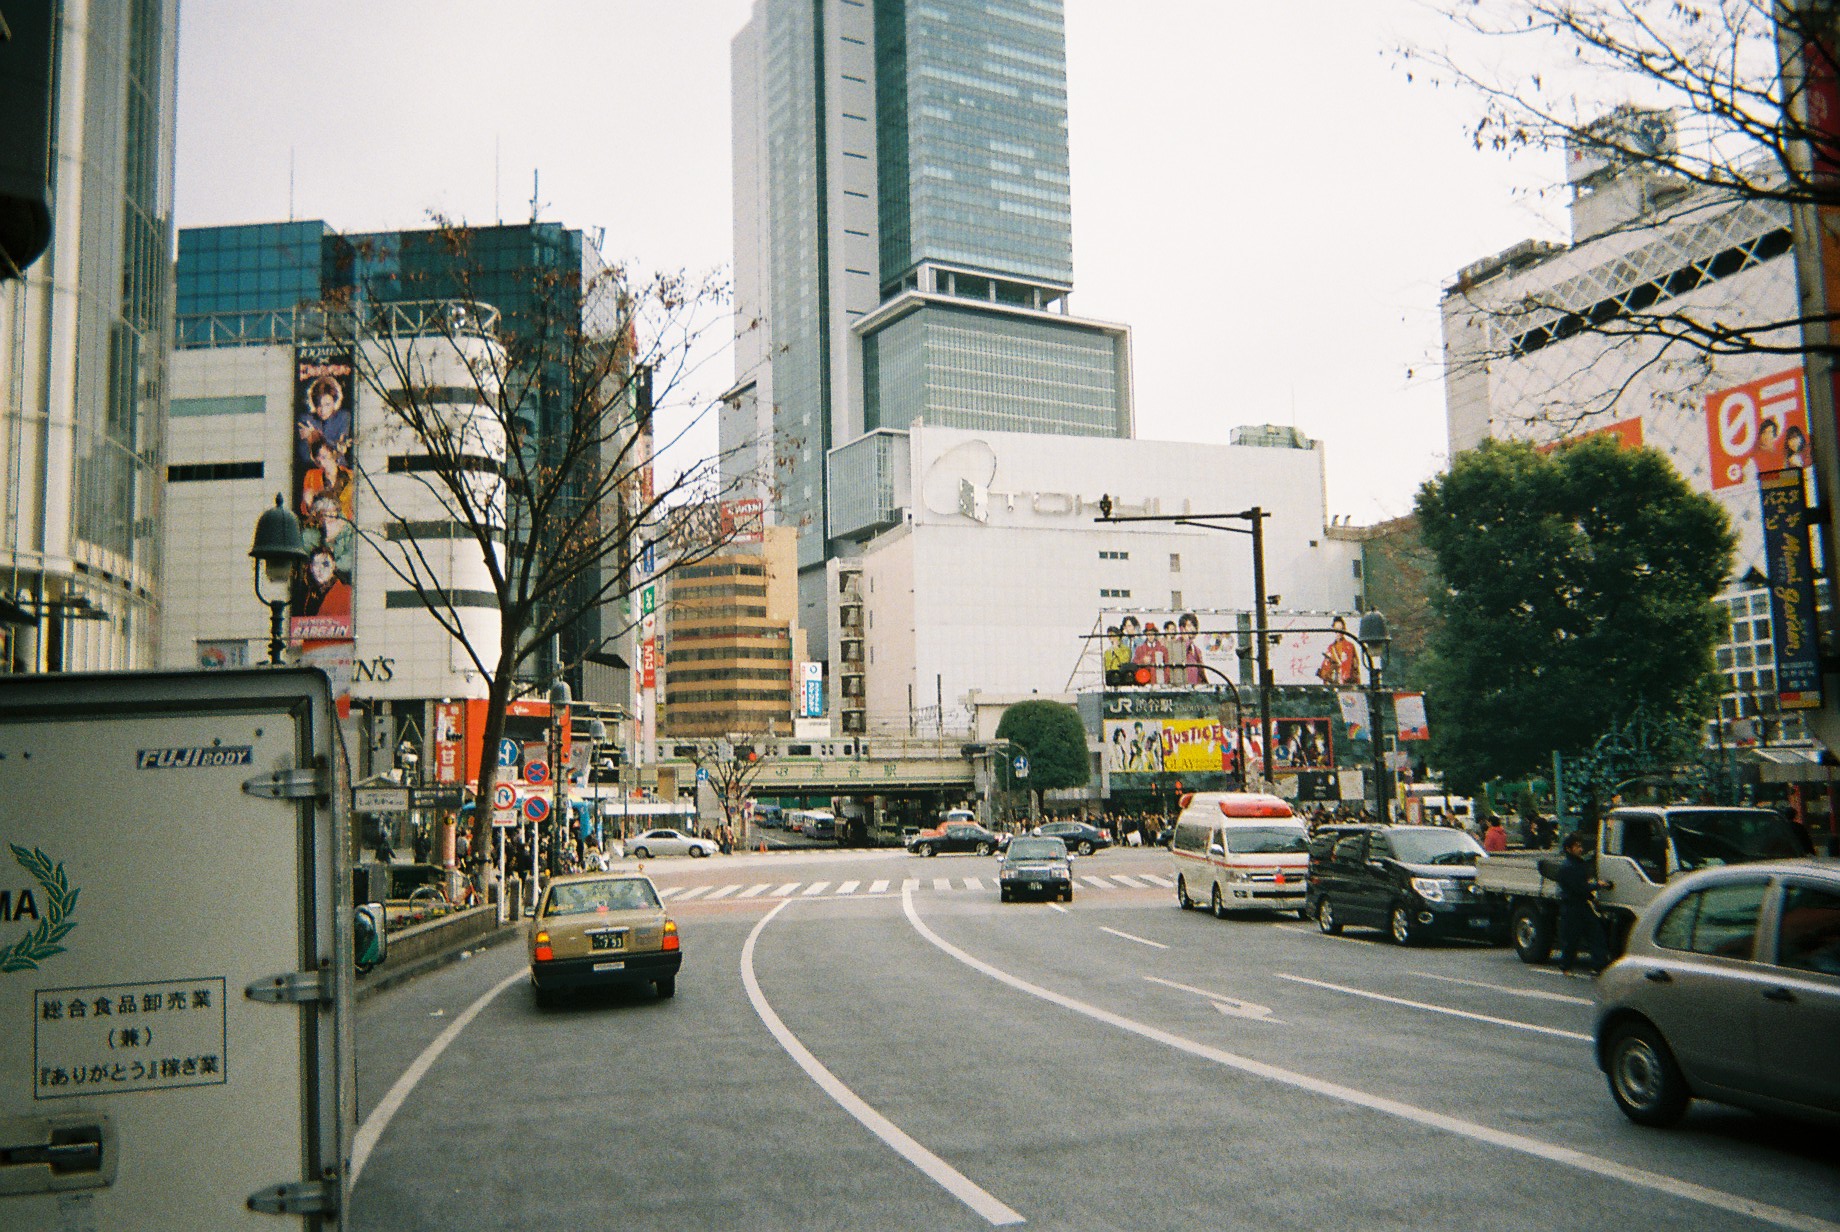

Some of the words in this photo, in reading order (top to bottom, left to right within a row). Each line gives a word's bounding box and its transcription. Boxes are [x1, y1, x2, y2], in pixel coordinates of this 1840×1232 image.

[352, 655, 395, 682] N'S
[1109, 697, 1133, 714] JR
[1135, 698, 1174, 713] 渋谷駅
[1162, 724, 1221, 757] JUSTICE
[42, 988, 212, 1019] 総合食品卸売業
[40, 1055, 219, 1087] 『ありがとう』稼ぎ業
